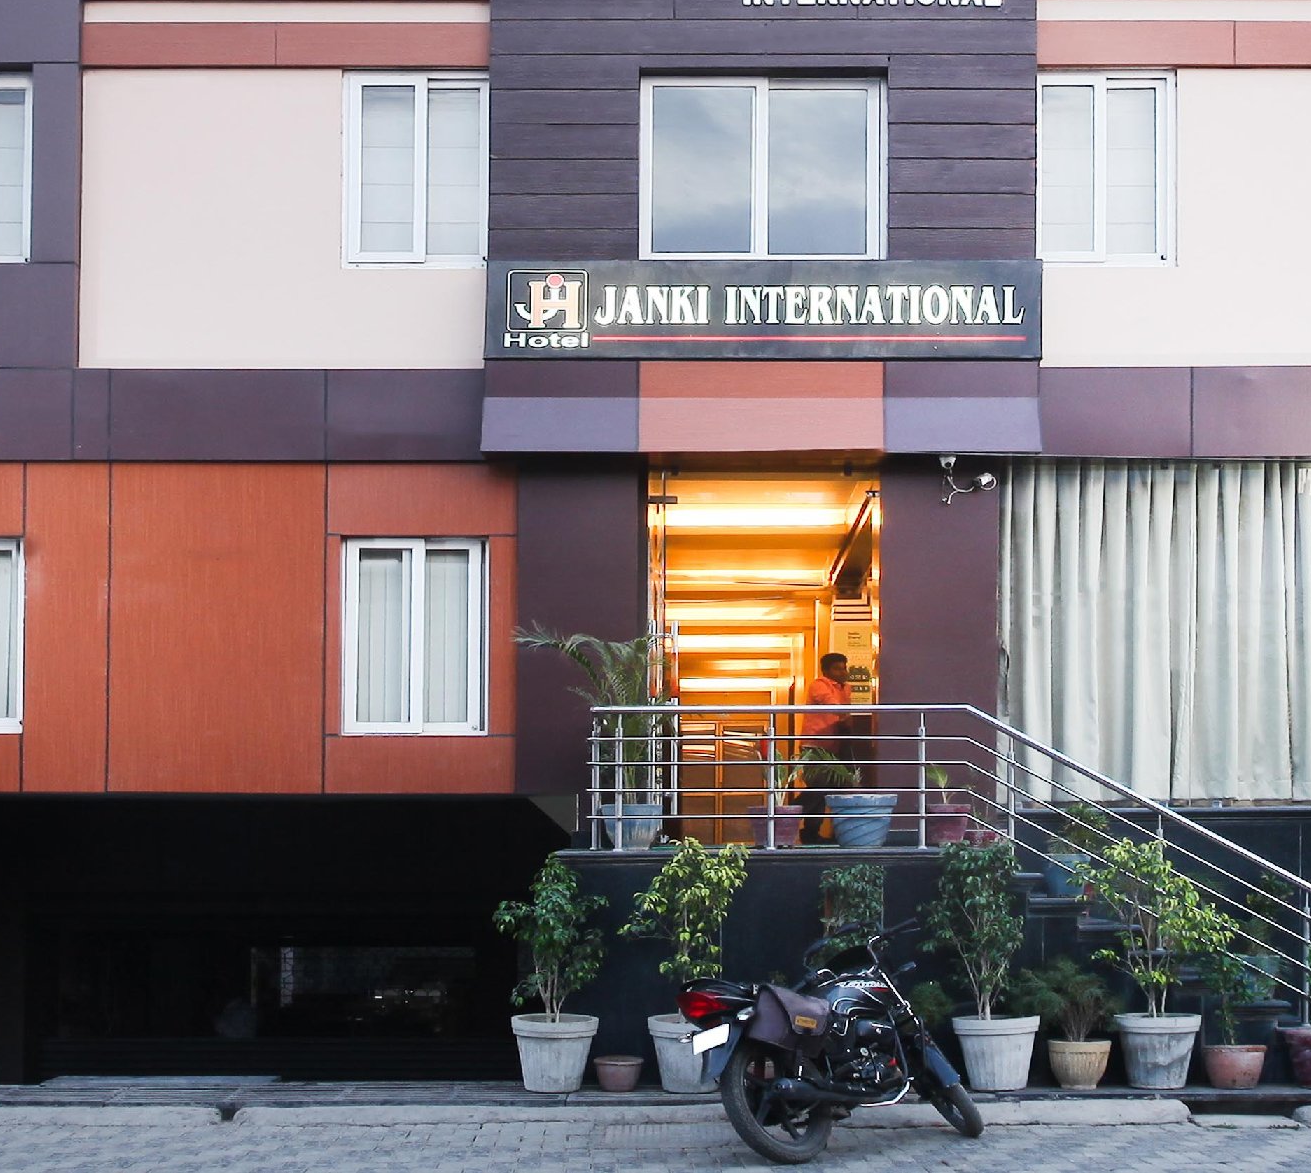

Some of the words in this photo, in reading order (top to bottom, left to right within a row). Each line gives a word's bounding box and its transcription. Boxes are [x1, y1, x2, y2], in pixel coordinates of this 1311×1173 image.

[593, 284, 711, 327] JANKI
[723, 283, 1026, 326] INTERNATIONAL
[502, 331, 591, 349] Hotel
